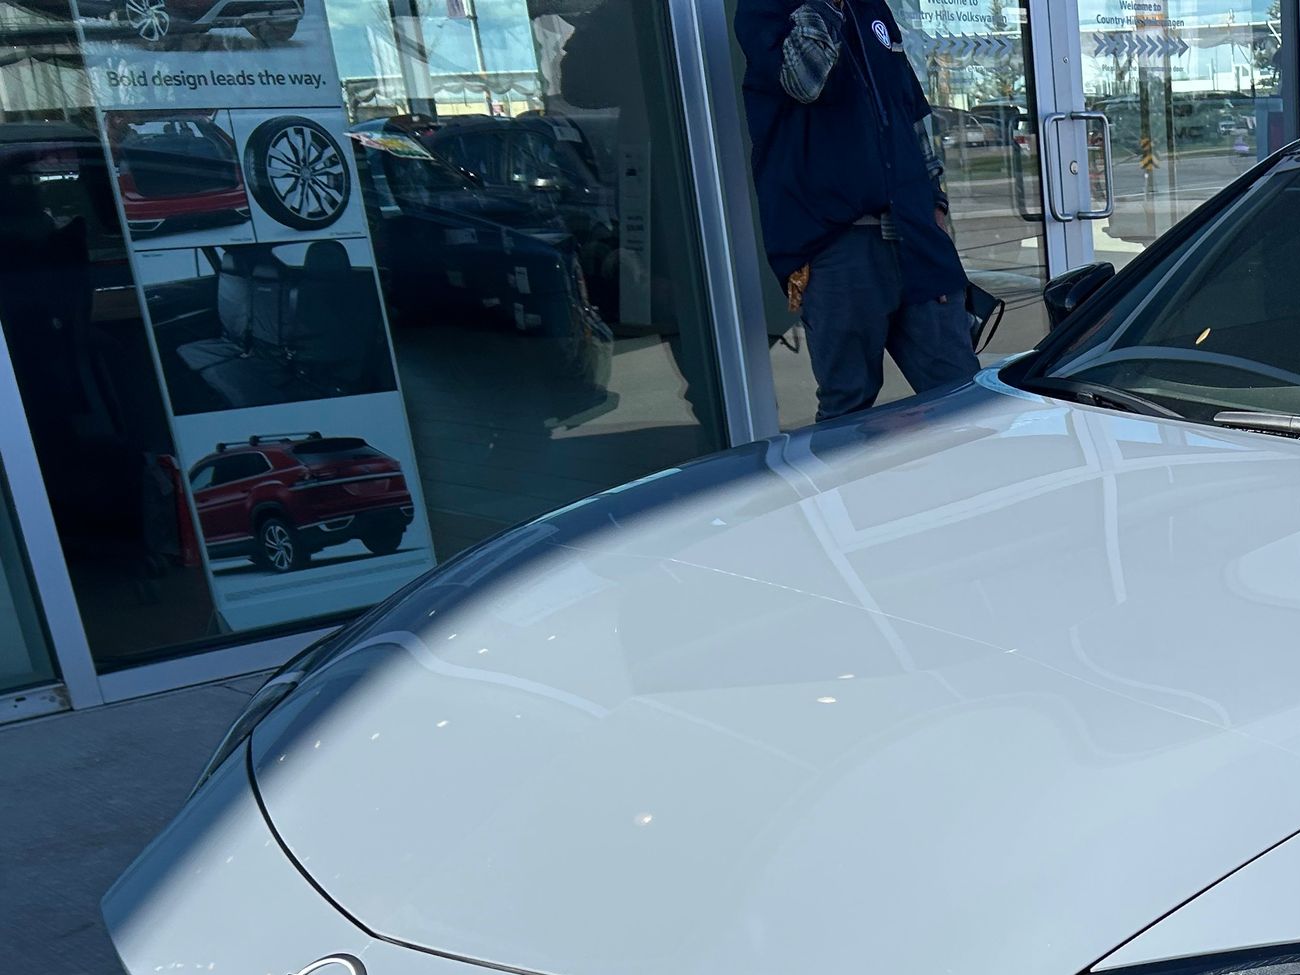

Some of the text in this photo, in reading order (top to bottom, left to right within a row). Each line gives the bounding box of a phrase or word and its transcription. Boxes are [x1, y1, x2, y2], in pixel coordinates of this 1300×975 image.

[935, 10, 955, 21] Hills
[956, 11, 1007, 23] Volkswan
[1096, 14, 1125, 26] Country
[106, 69, 326, 90] Bold design leads the way.
